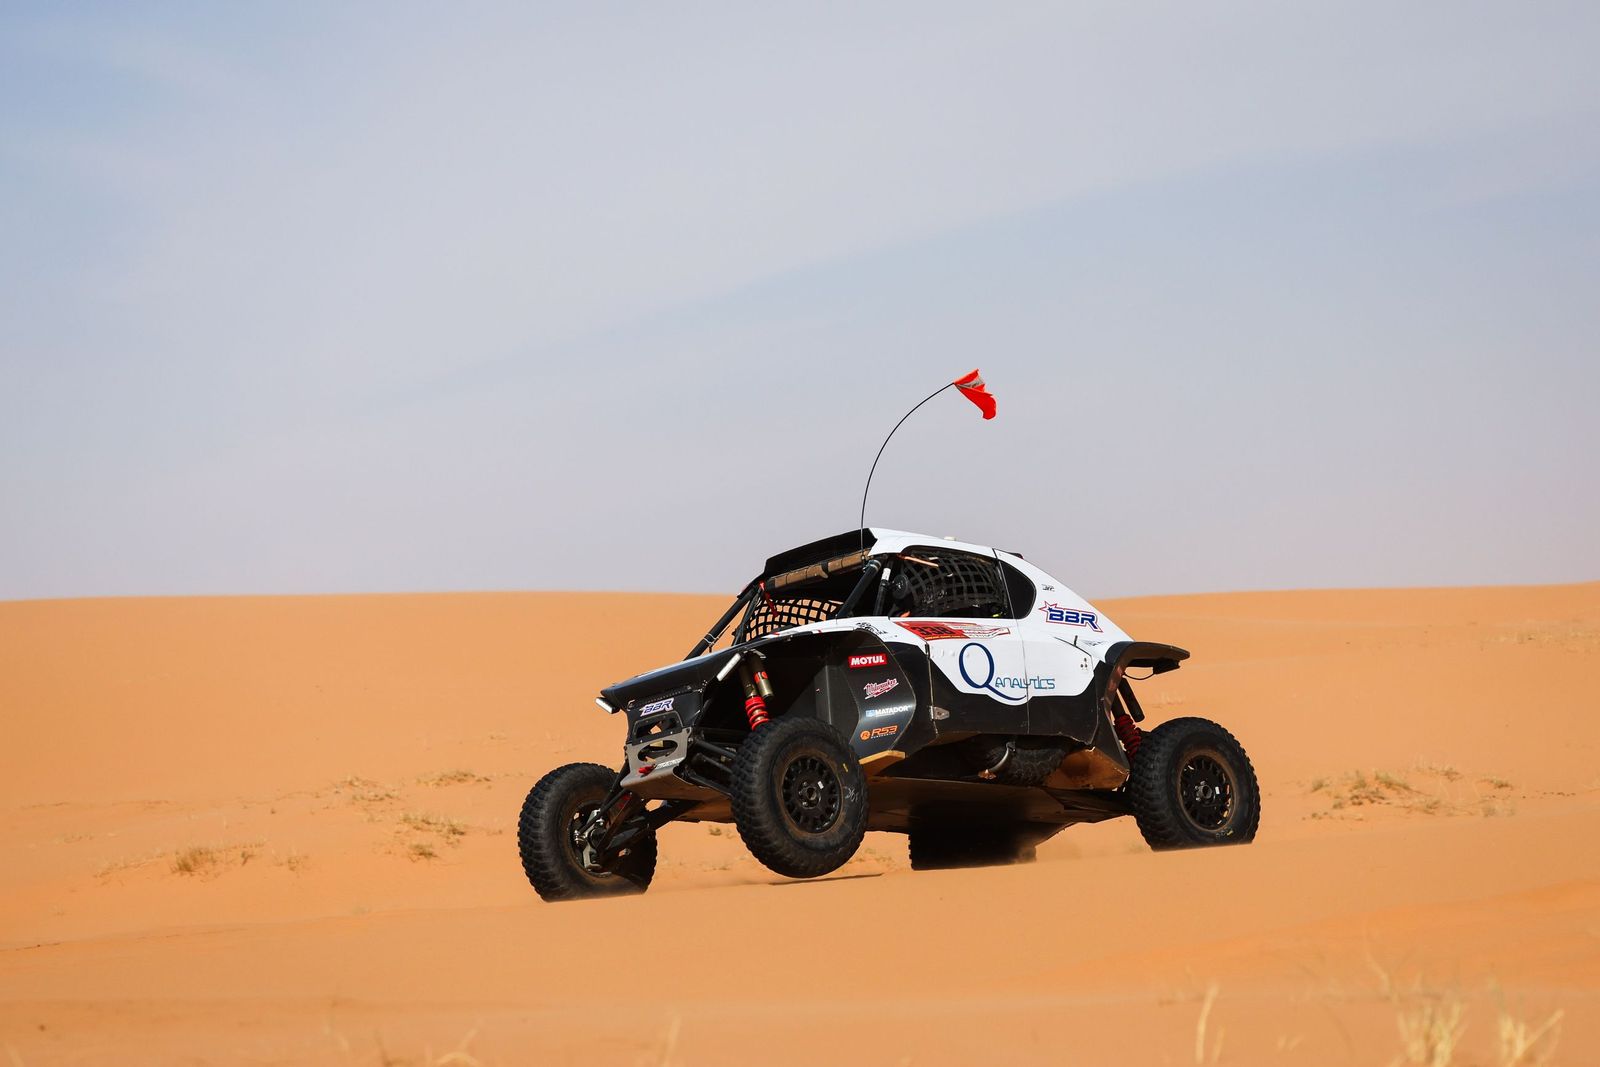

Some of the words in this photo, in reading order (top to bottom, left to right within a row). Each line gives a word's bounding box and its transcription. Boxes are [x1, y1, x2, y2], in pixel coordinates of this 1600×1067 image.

[1047, 606, 1098, 629] BBR
[850, 655, 885, 666] MOTUL
[958, 642, 1027, 701] Q
[875, 705, 909, 715] MATADOR
